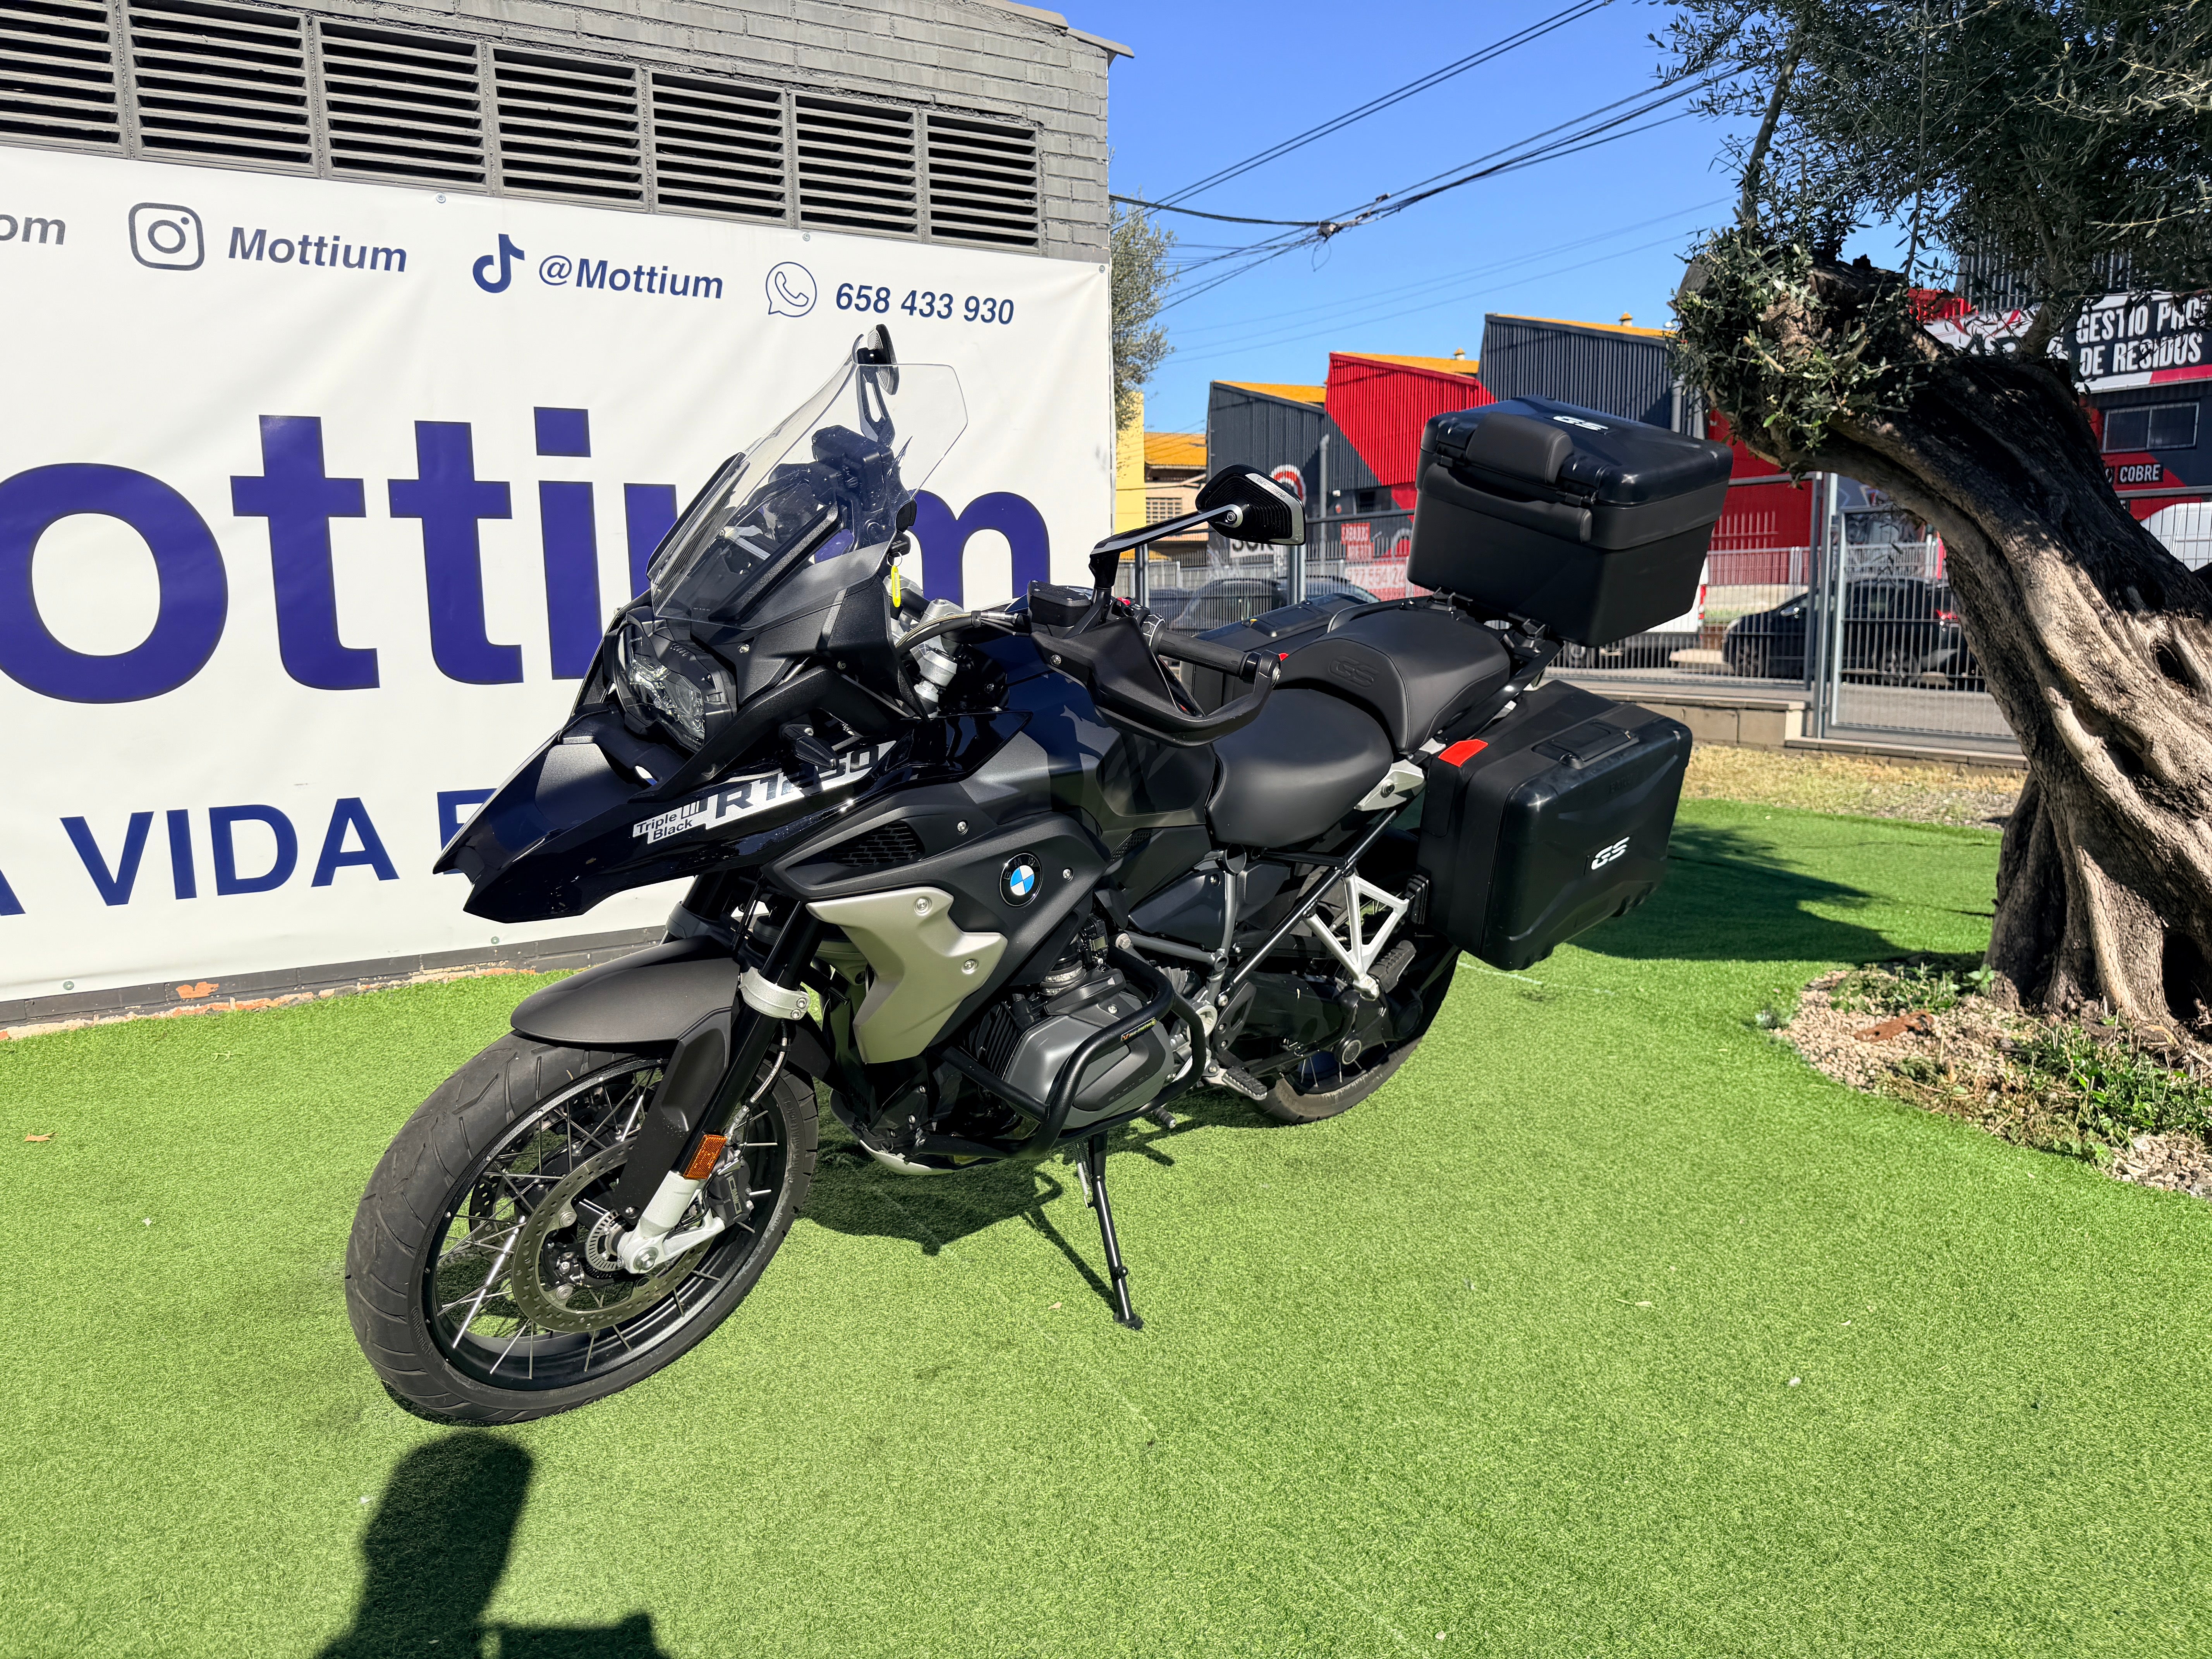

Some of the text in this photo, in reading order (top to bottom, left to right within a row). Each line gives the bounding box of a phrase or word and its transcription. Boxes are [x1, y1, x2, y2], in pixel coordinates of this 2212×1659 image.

[229, 227, 406, 272] Mottium
[539, 256, 723, 299] @Mottium
[836, 283, 1014, 325] 658 433 930
[2079, 345, 2106, 377] DE
[1553, 416, 1609, 431] GS
[2119, 464, 2161, 483] COBRE
[637, 812, 677, 833] Triple
[653, 818, 693, 840] Black
[60, 797, 400, 906] VIDA
[1591, 836, 1631, 870] GS
[1003, 856, 1036, 880] BMW
